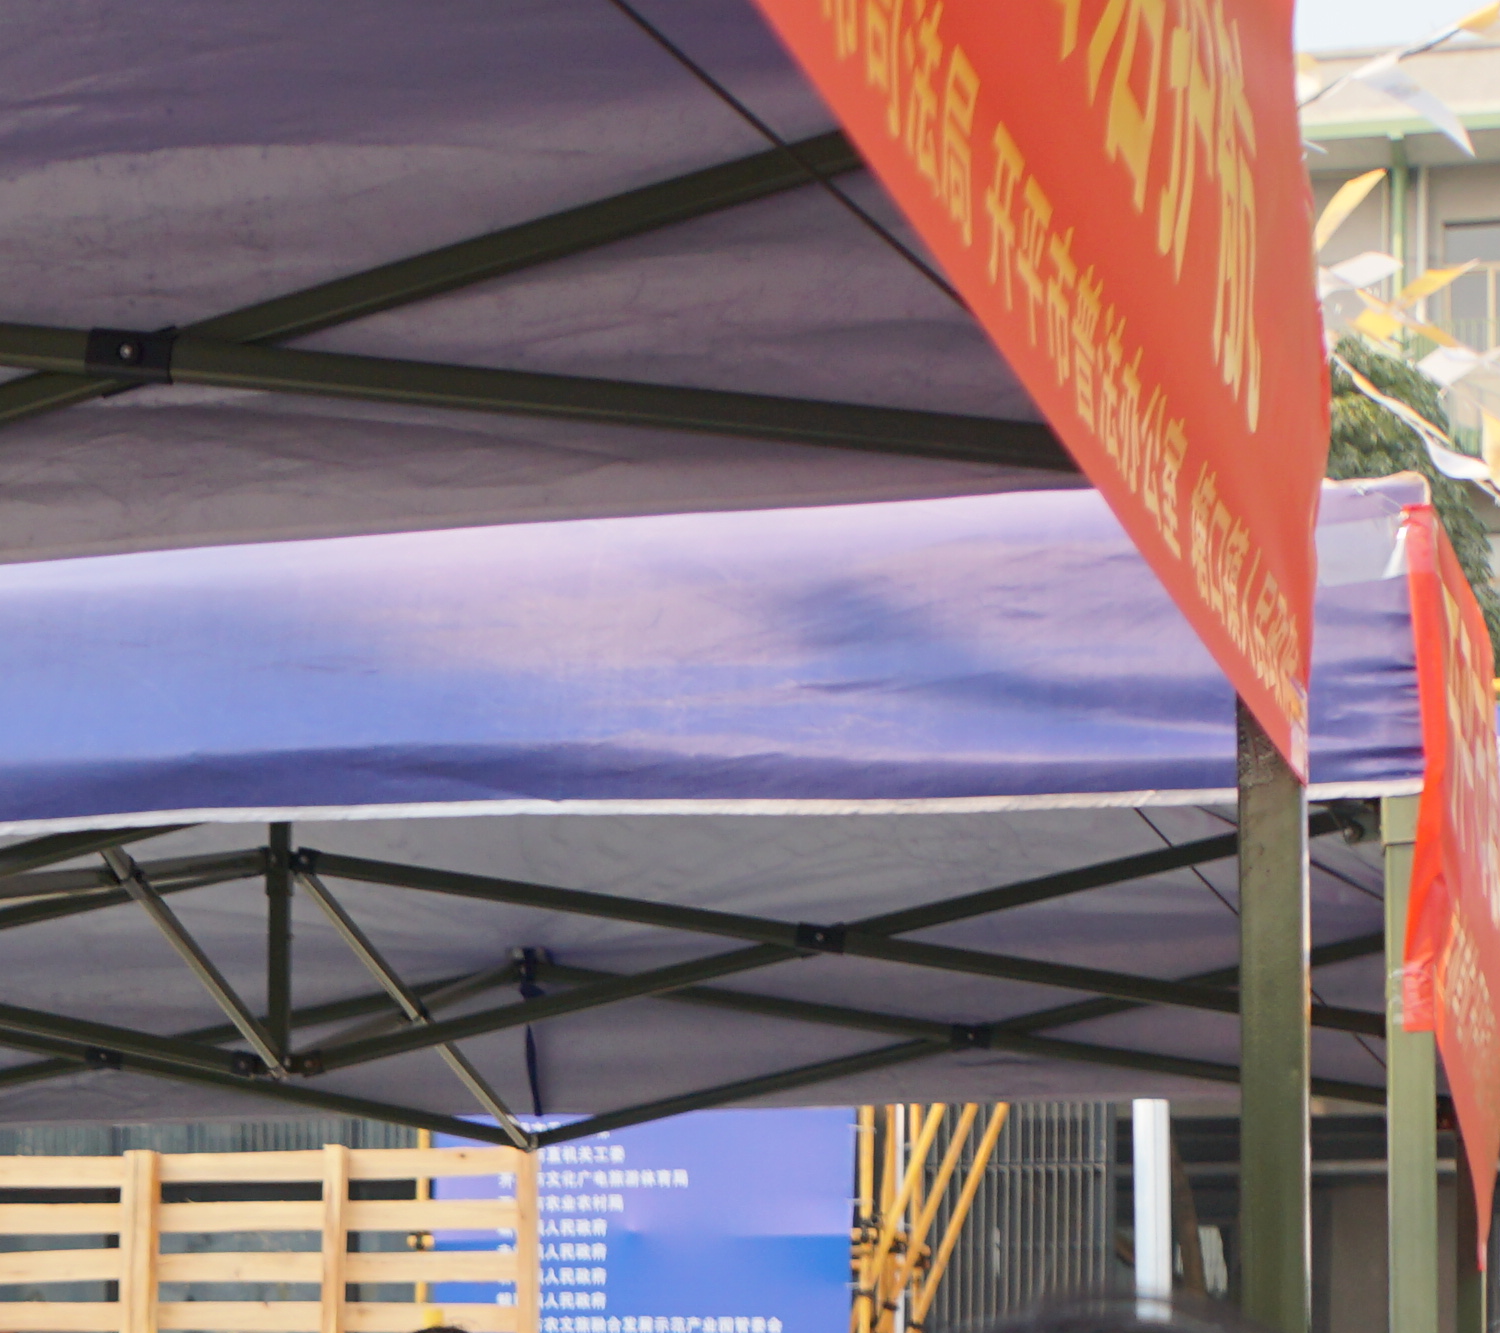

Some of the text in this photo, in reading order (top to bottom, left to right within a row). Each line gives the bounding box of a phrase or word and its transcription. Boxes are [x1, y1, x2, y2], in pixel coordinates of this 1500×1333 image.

[986, 120, 1189, 561] 开平市普法办公室
[1055, 0, 1260, 434] 治护航
